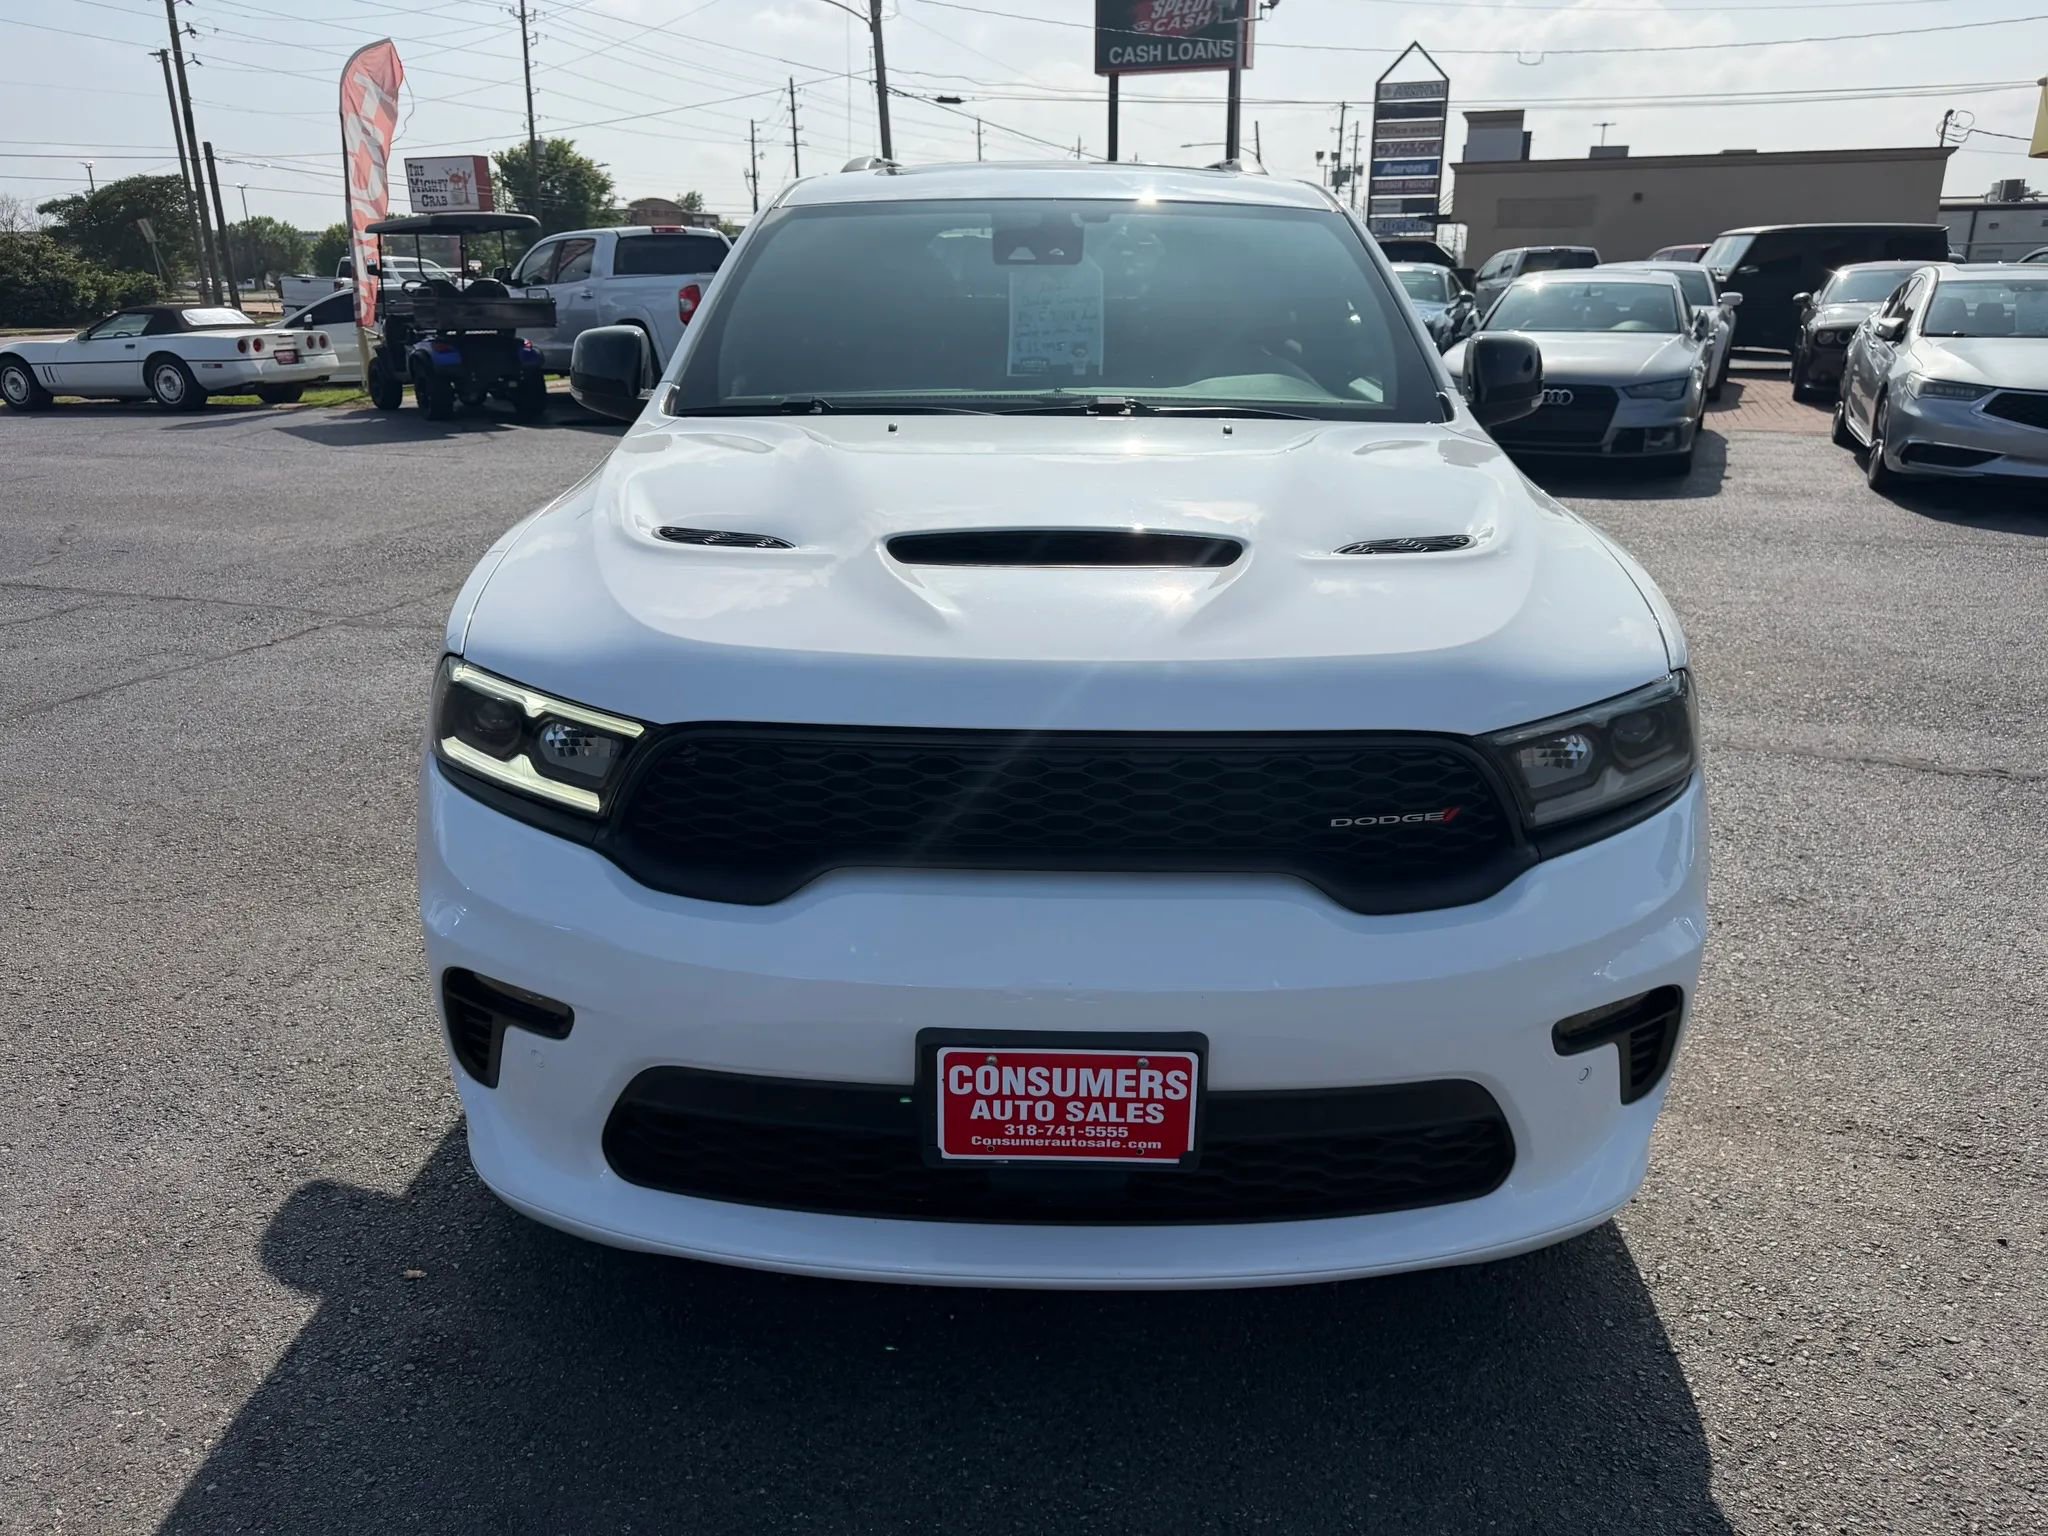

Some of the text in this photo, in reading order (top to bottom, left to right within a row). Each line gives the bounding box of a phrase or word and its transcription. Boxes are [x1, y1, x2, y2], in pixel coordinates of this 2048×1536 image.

[1109, 41, 1233, 64] CASH LOANS
[421, 194, 448, 207] CRAB
[1331, 812, 1445, 827] DODGE
[949, 1065, 1188, 1100] CONSUMERS
[970, 1100, 1164, 1124] AUTO SALES
[1004, 1124, 1129, 1138] 318-741-5555
[971, 1136, 1162, 1149] Consumerautosale.com
